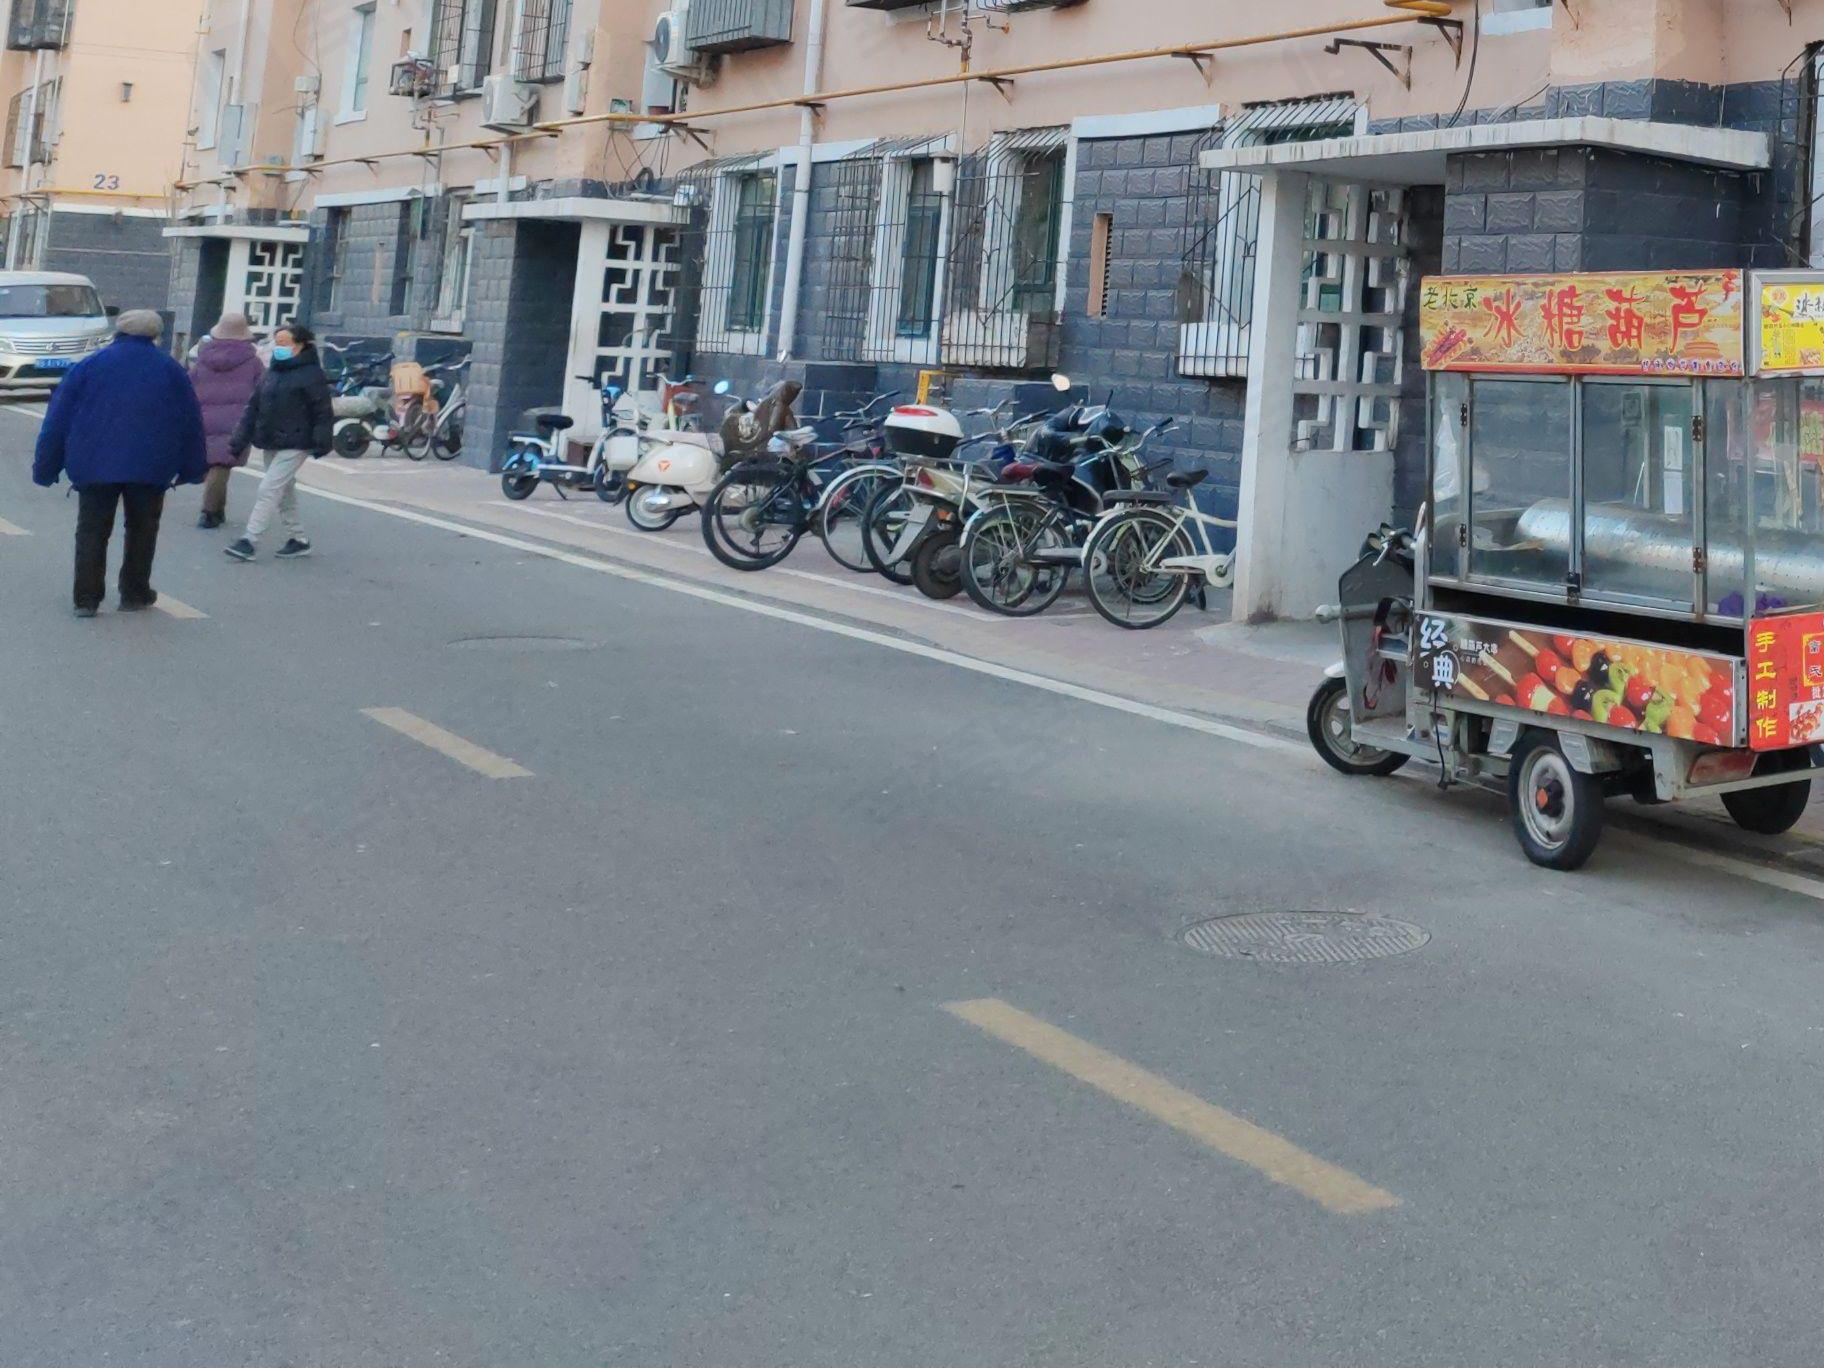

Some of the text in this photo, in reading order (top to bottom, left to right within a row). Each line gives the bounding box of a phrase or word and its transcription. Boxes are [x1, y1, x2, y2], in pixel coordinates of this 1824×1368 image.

[94, 174, 119, 190] 23
[1423, 285, 1478, 310] 老北京
[1482, 282, 1709, 354] 冰糖葫芦
[1420, 616, 1455, 690] 经典
[1755, 630, 1778, 739] 手工制作
